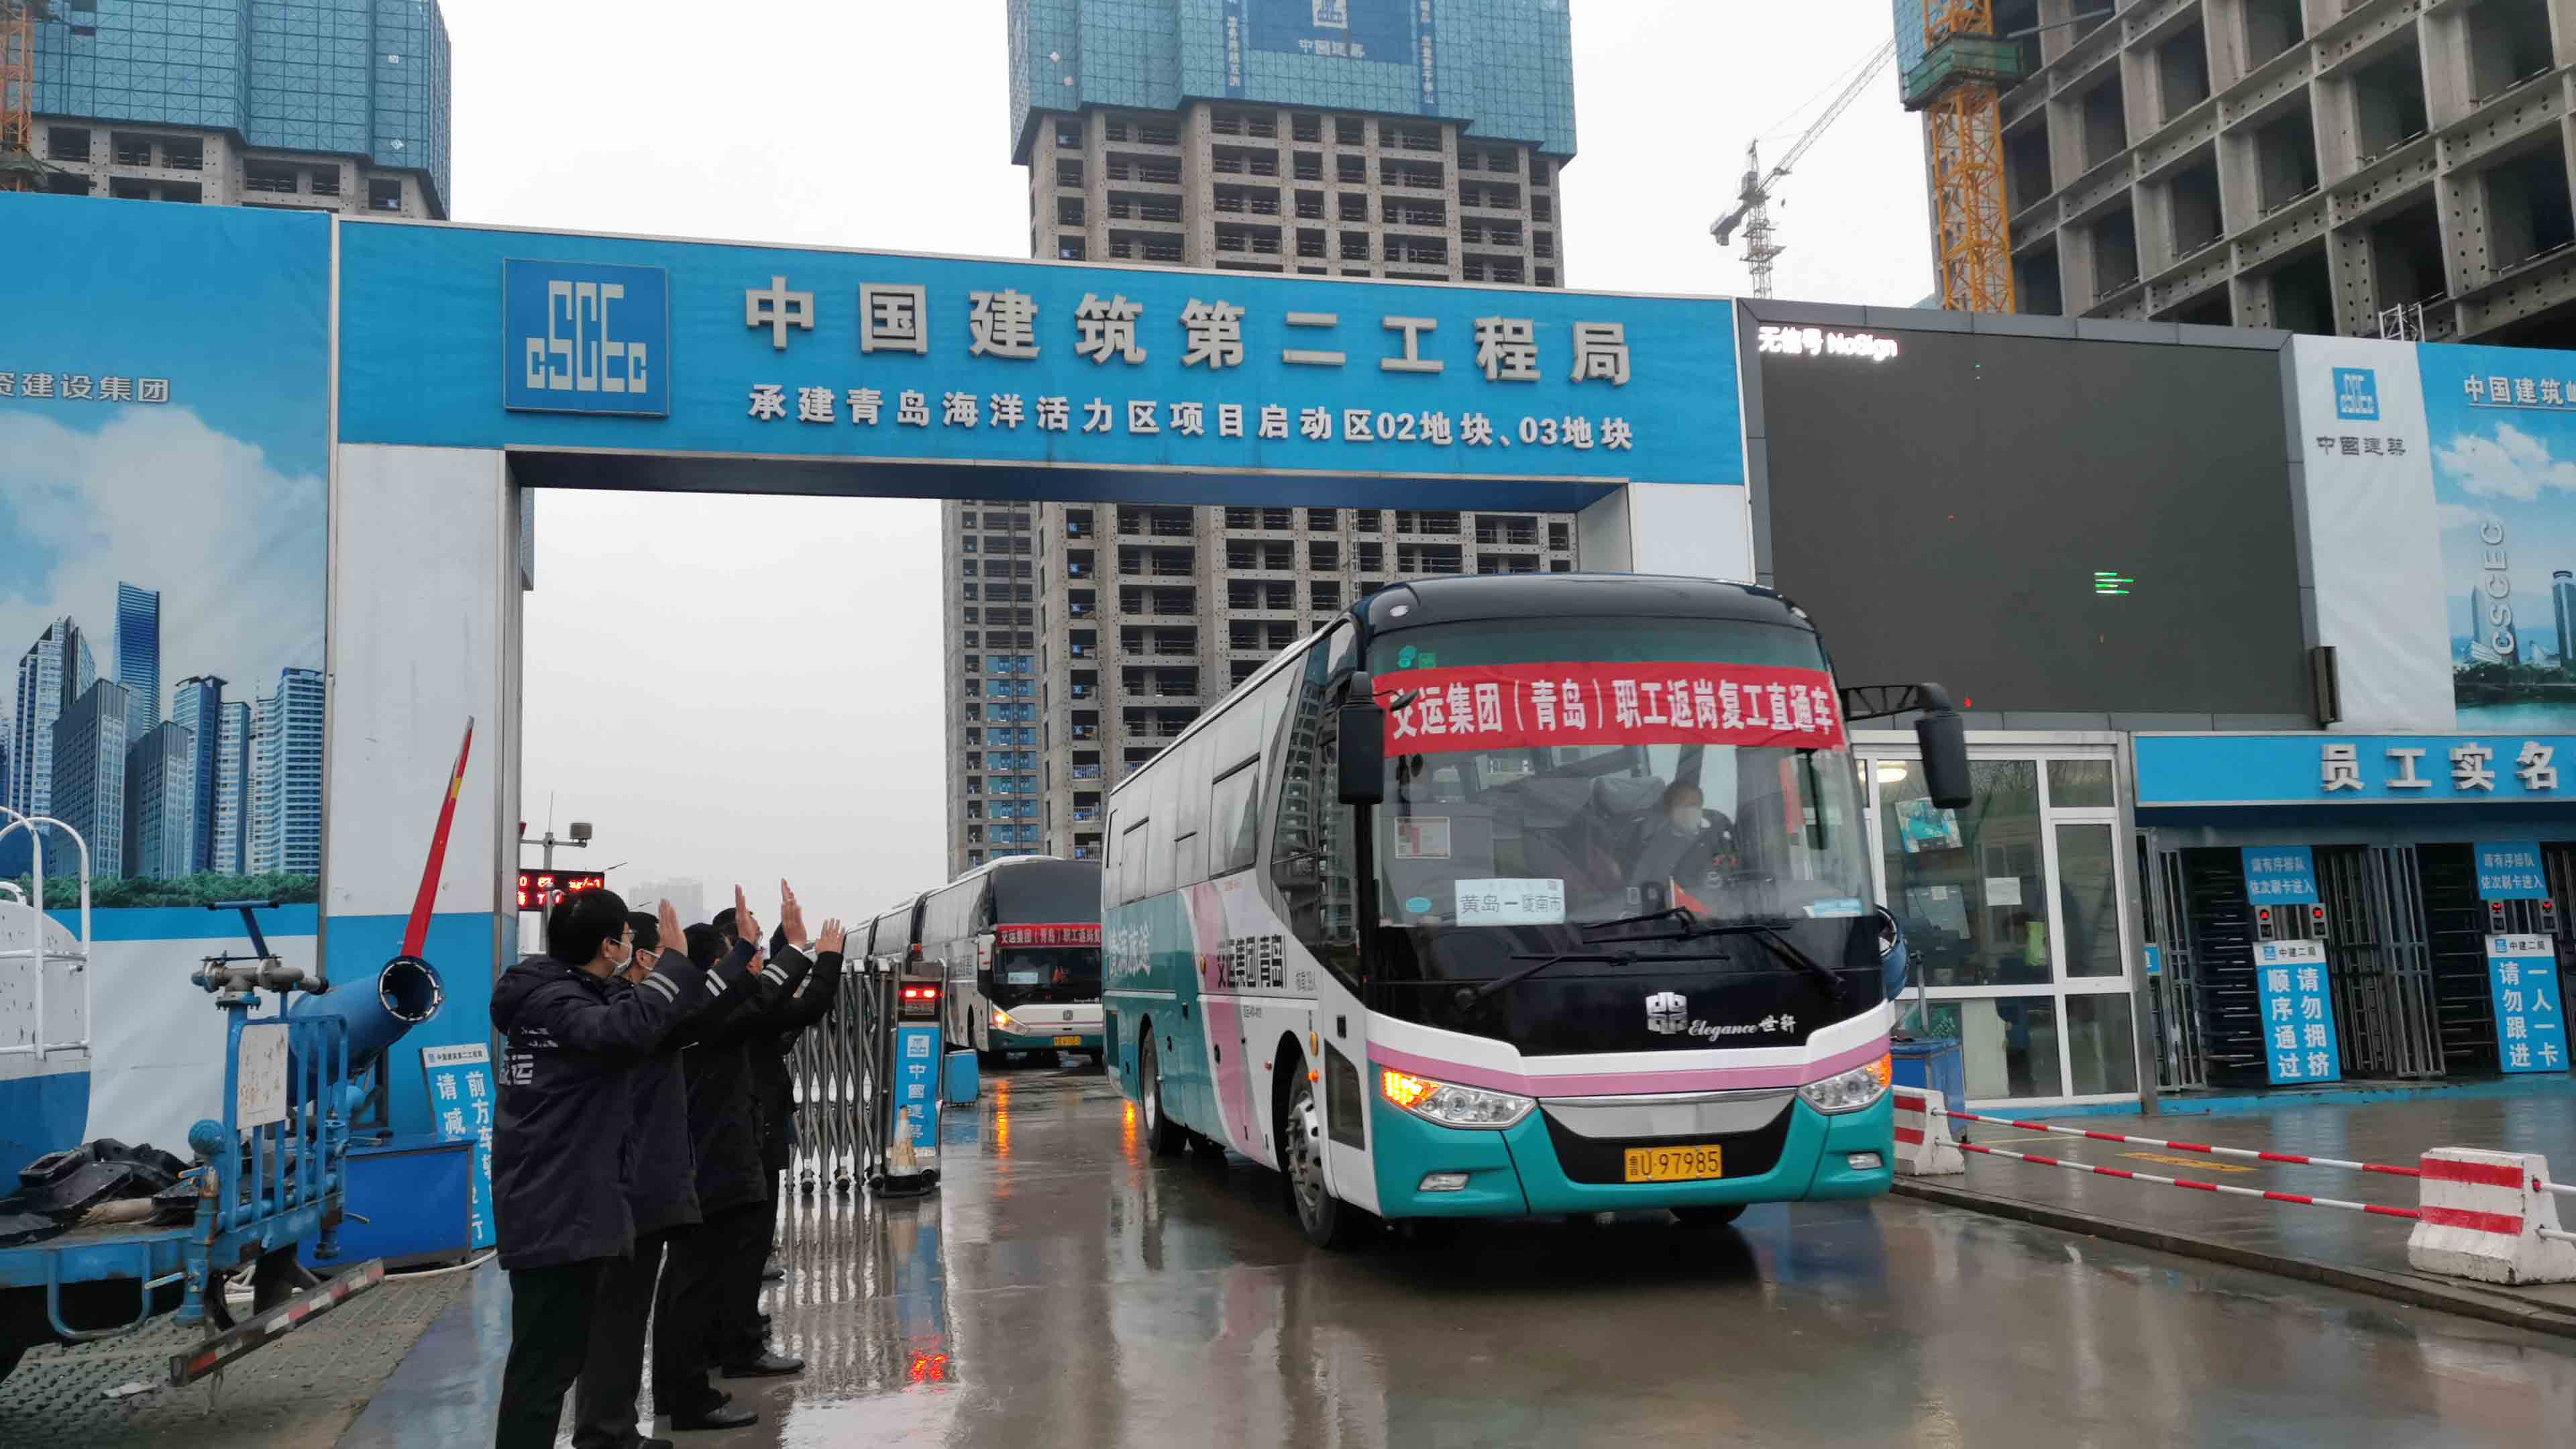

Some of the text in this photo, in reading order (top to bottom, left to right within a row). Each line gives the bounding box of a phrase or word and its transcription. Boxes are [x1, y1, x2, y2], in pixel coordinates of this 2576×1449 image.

[745, 275, 1632, 387] 中国建筑第二工程局
[748, 384, 1633, 451] 承建青岛海洋活力区项目启动区02地块、03地块
[2320, 741, 2559, 791] 员工实名
[1688, 1019, 1758, 1042] Elegance
[2267, 969, 2302, 1077] 顺序通过
[2297, 967, 2329, 1077] 请勿拥挤
[2498, 961, 2532, 1067] 请勿跟进
[2527, 969, 2559, 1067] 一人一卡
